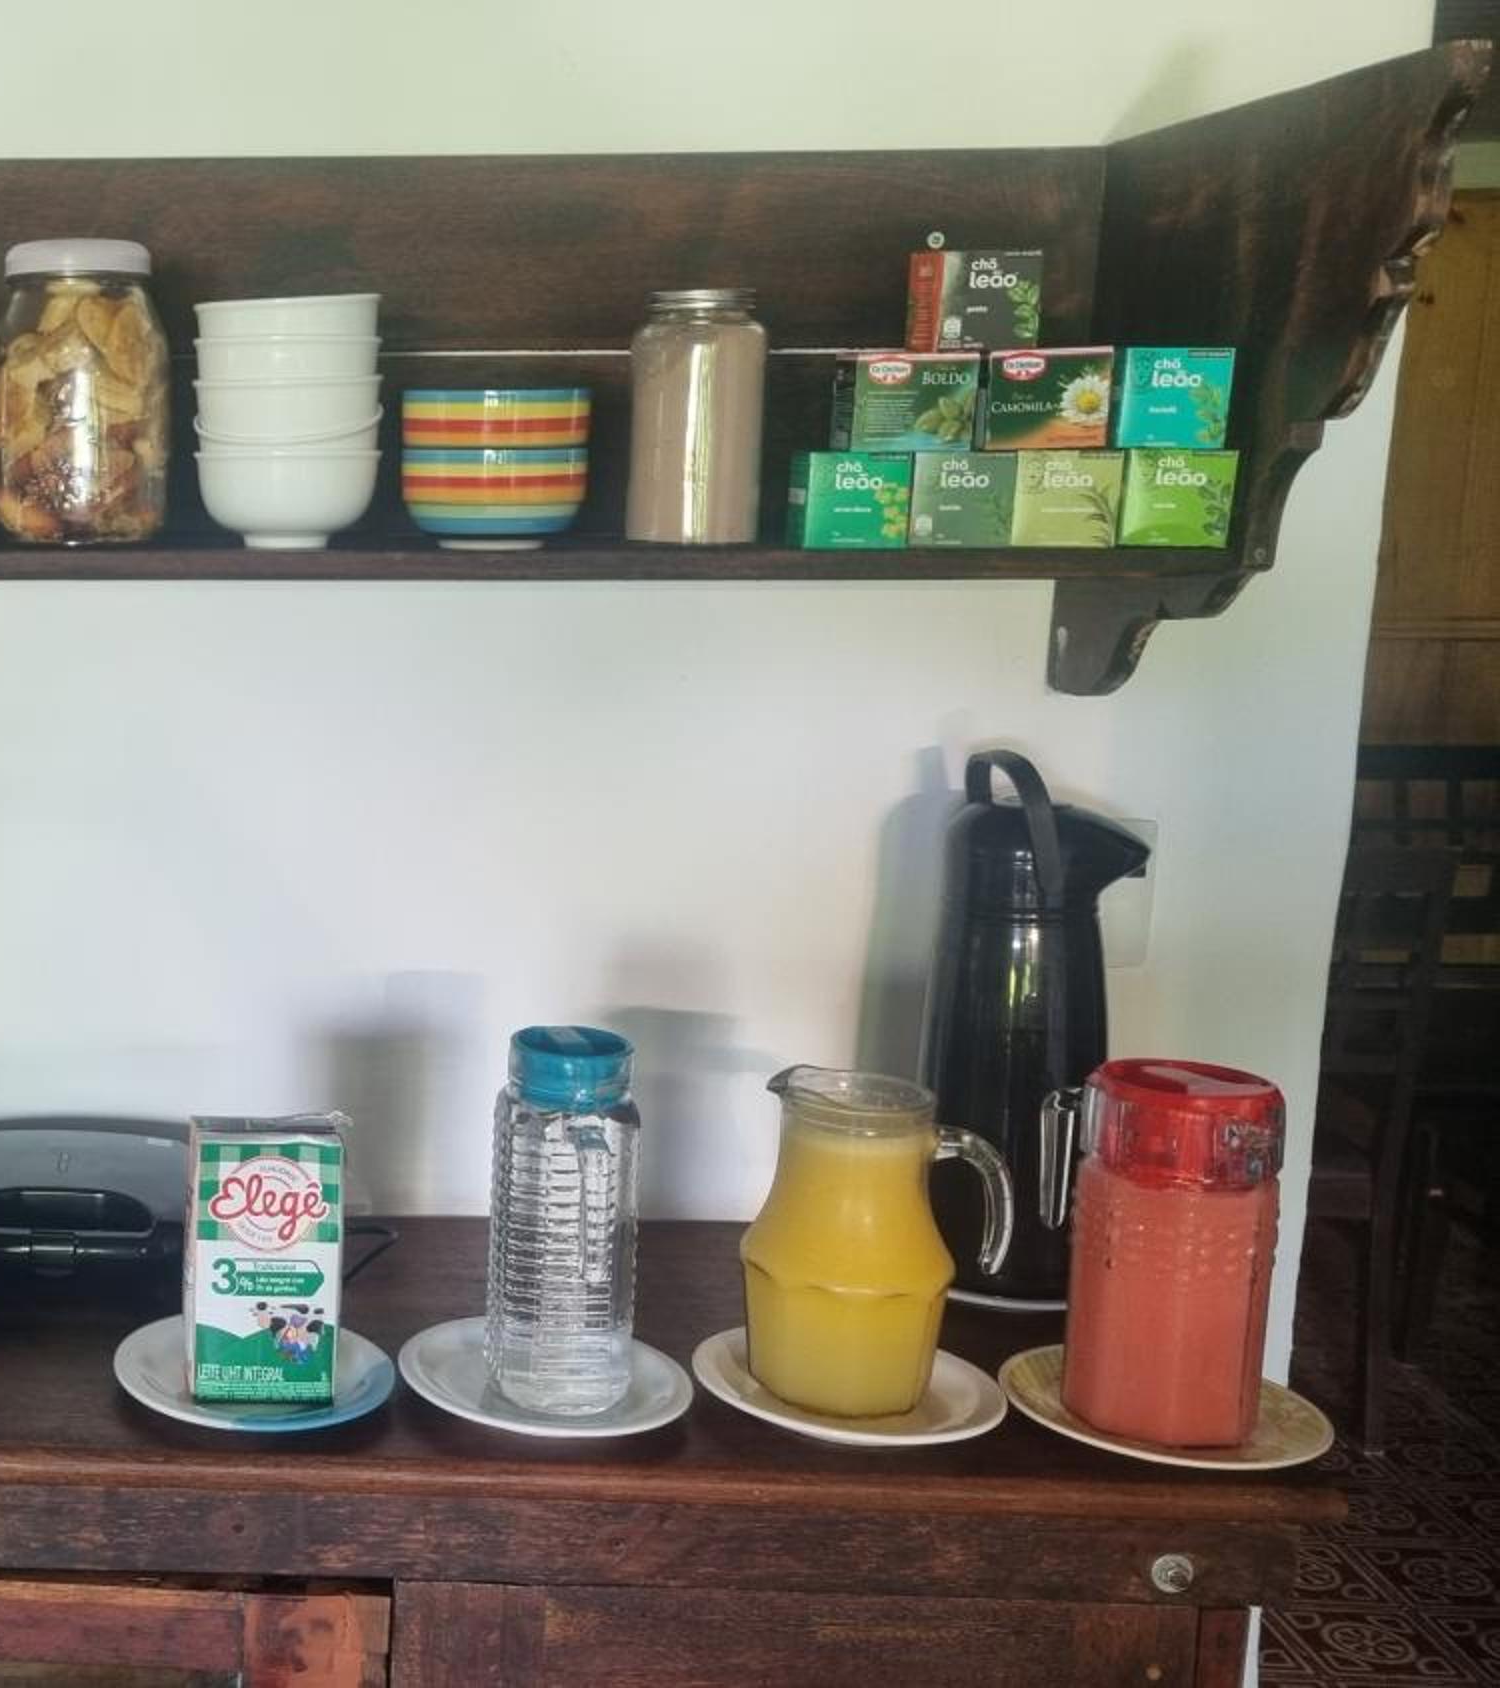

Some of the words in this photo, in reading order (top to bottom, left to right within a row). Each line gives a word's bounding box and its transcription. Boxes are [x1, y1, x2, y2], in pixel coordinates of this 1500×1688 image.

[922, 371, 971, 385] BOLDO
[991, 401, 1053, 413] CAMOMILA
[940, 471, 990, 488] leão
[209, 1173, 327, 1241] Elegê
[197, 1363, 220, 1378] LEITE
[221, 1364, 241, 1379] UHT
[243, 1365, 284, 1381] INTEGRAL
